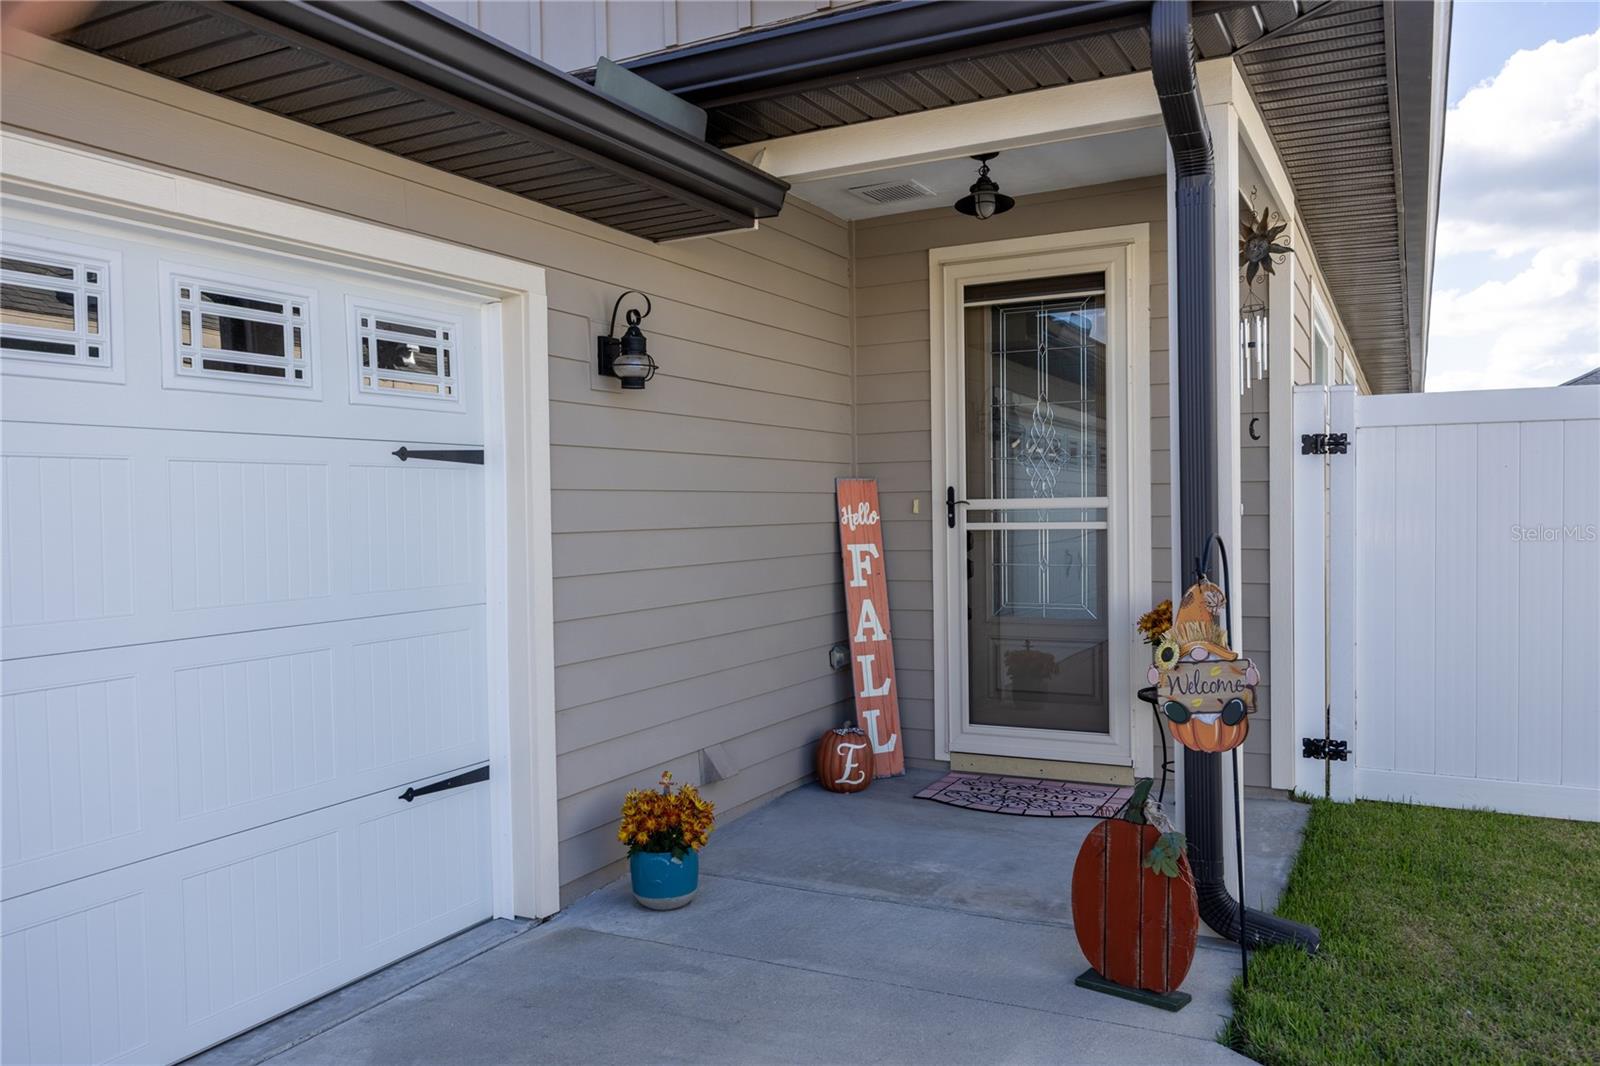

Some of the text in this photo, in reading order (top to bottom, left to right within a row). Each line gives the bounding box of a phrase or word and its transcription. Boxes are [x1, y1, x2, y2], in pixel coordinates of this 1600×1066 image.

[840, 501, 880, 531] Hello
[847, 543, 897, 755] FALL
[1167, 669, 1246, 696] Welcome
